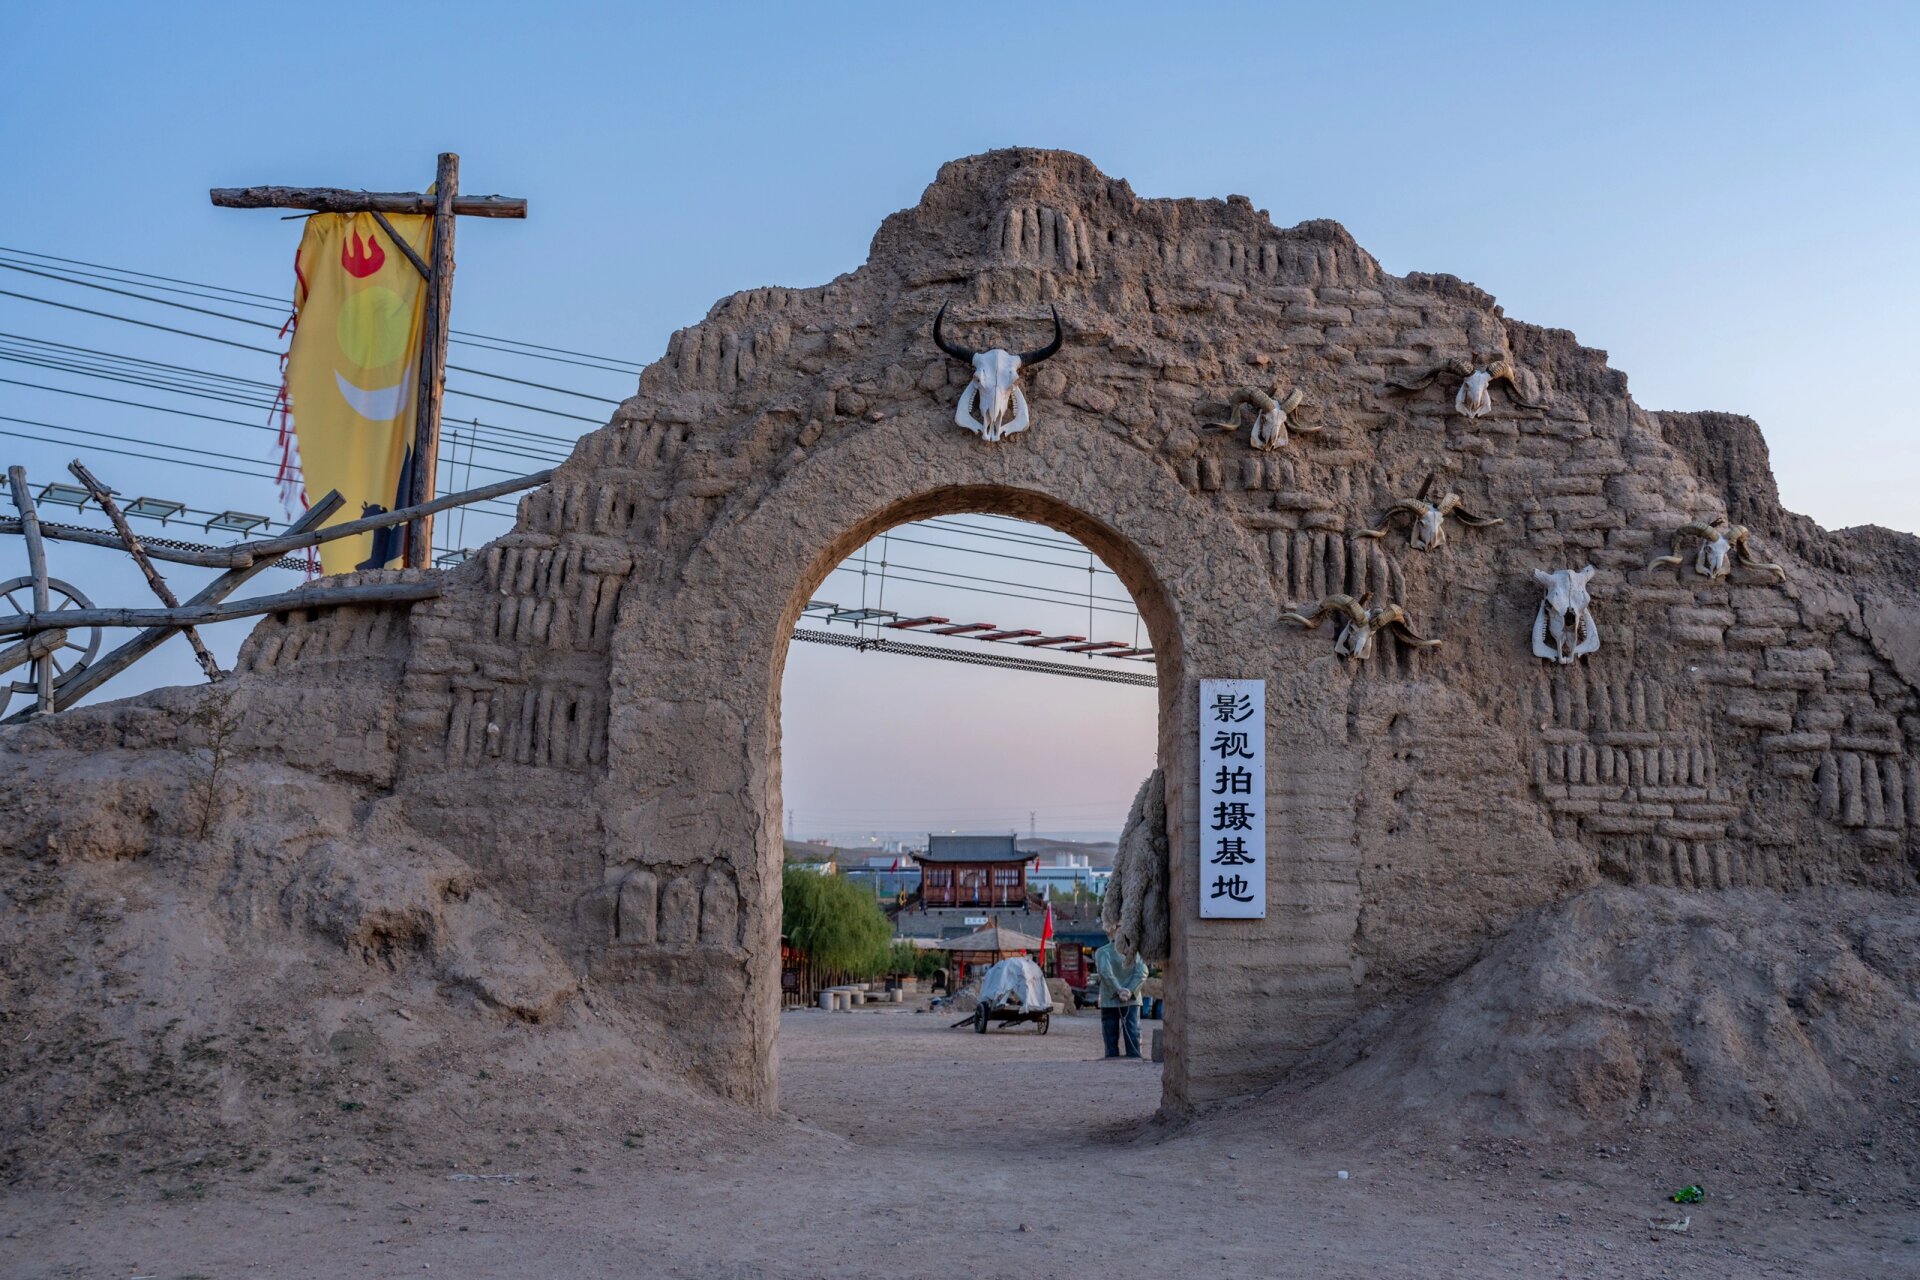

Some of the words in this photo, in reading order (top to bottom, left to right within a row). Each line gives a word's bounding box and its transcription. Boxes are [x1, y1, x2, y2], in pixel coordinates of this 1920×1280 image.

[1210, 693, 1256, 903] 影视拍摄基地
